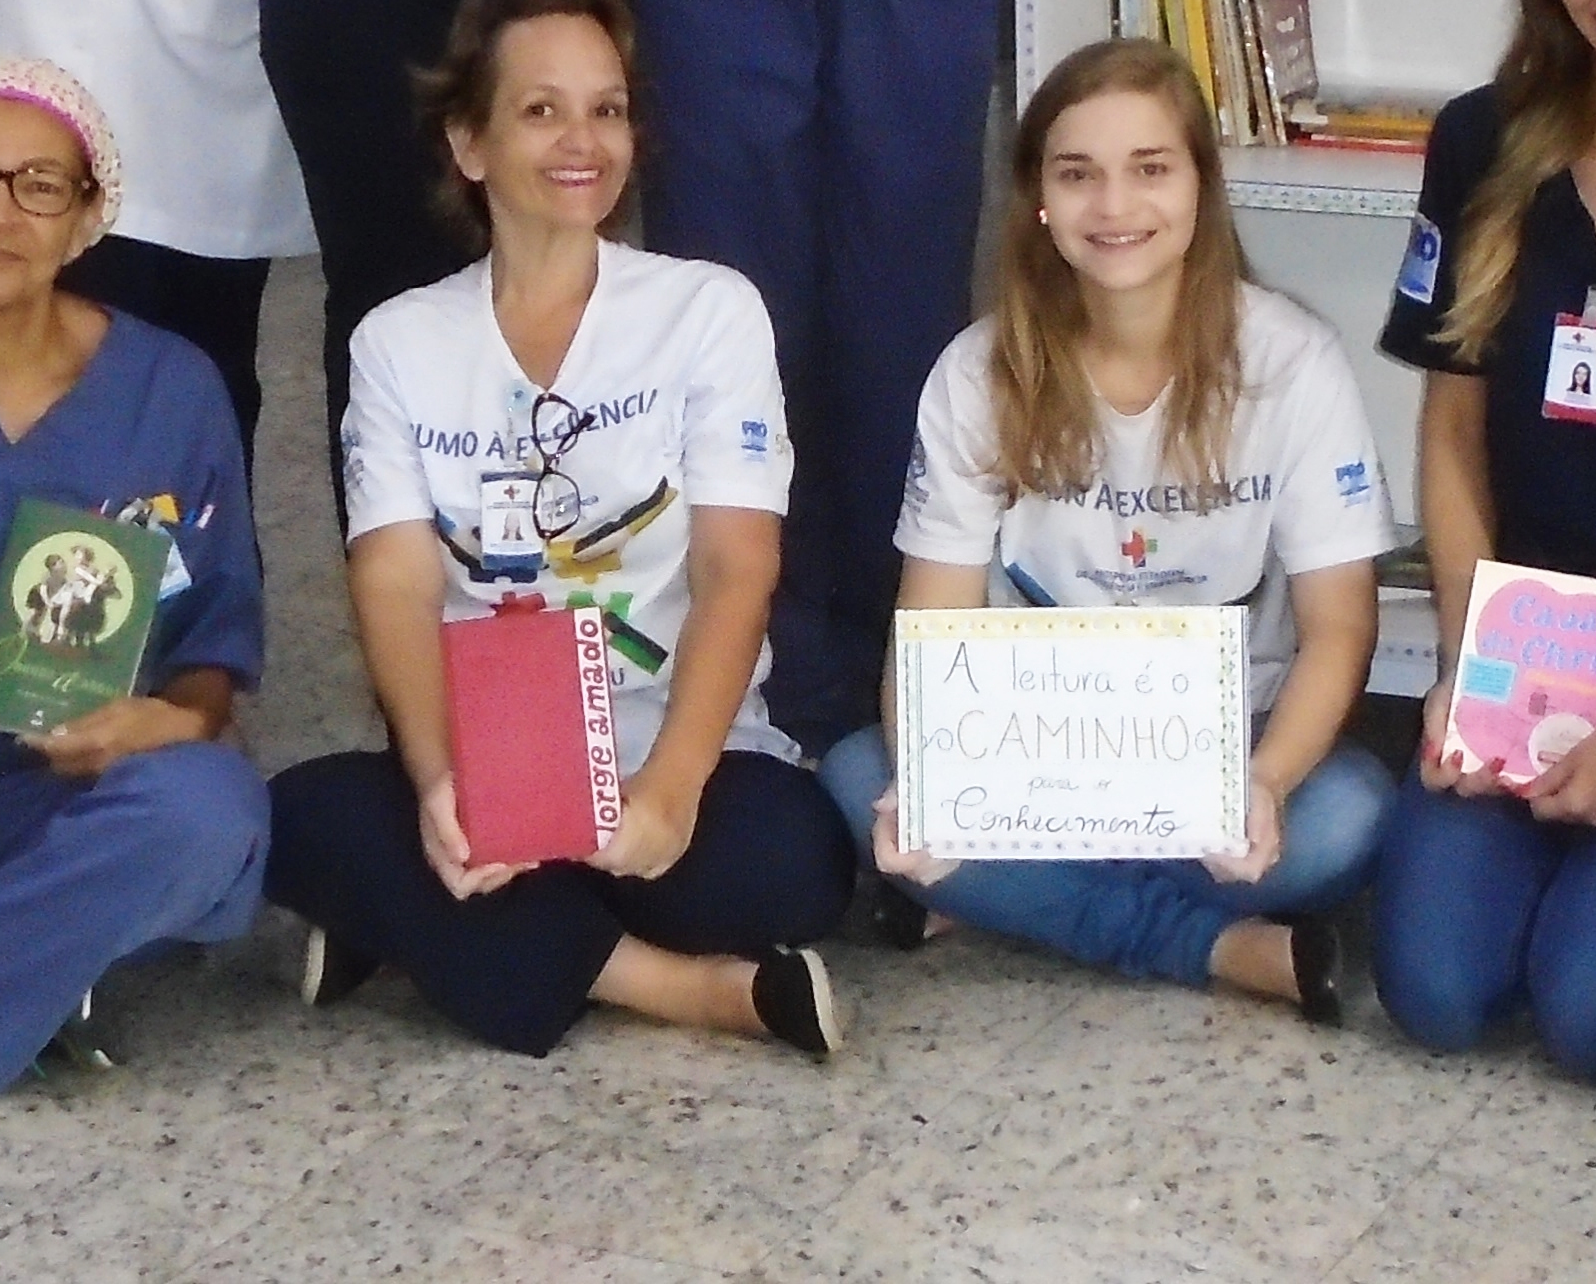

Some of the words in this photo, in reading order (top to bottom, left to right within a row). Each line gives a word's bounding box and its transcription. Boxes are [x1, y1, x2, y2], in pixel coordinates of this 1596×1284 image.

[410, 423, 478, 458] UMO
[1115, 474, 1271, 518] EXCELCIA
[575, 619, 610, 736] amado
[943, 641, 980, 694] A
[1012, 644, 1117, 694] leitura
[1134, 660, 1154, 694] é
[1171, 673, 1190, 694] o
[956, 709, 1190, 761] CAMINHO
[940, 785, 1189, 838] Conhecimento
[1027, 776, 1080, 797] para
